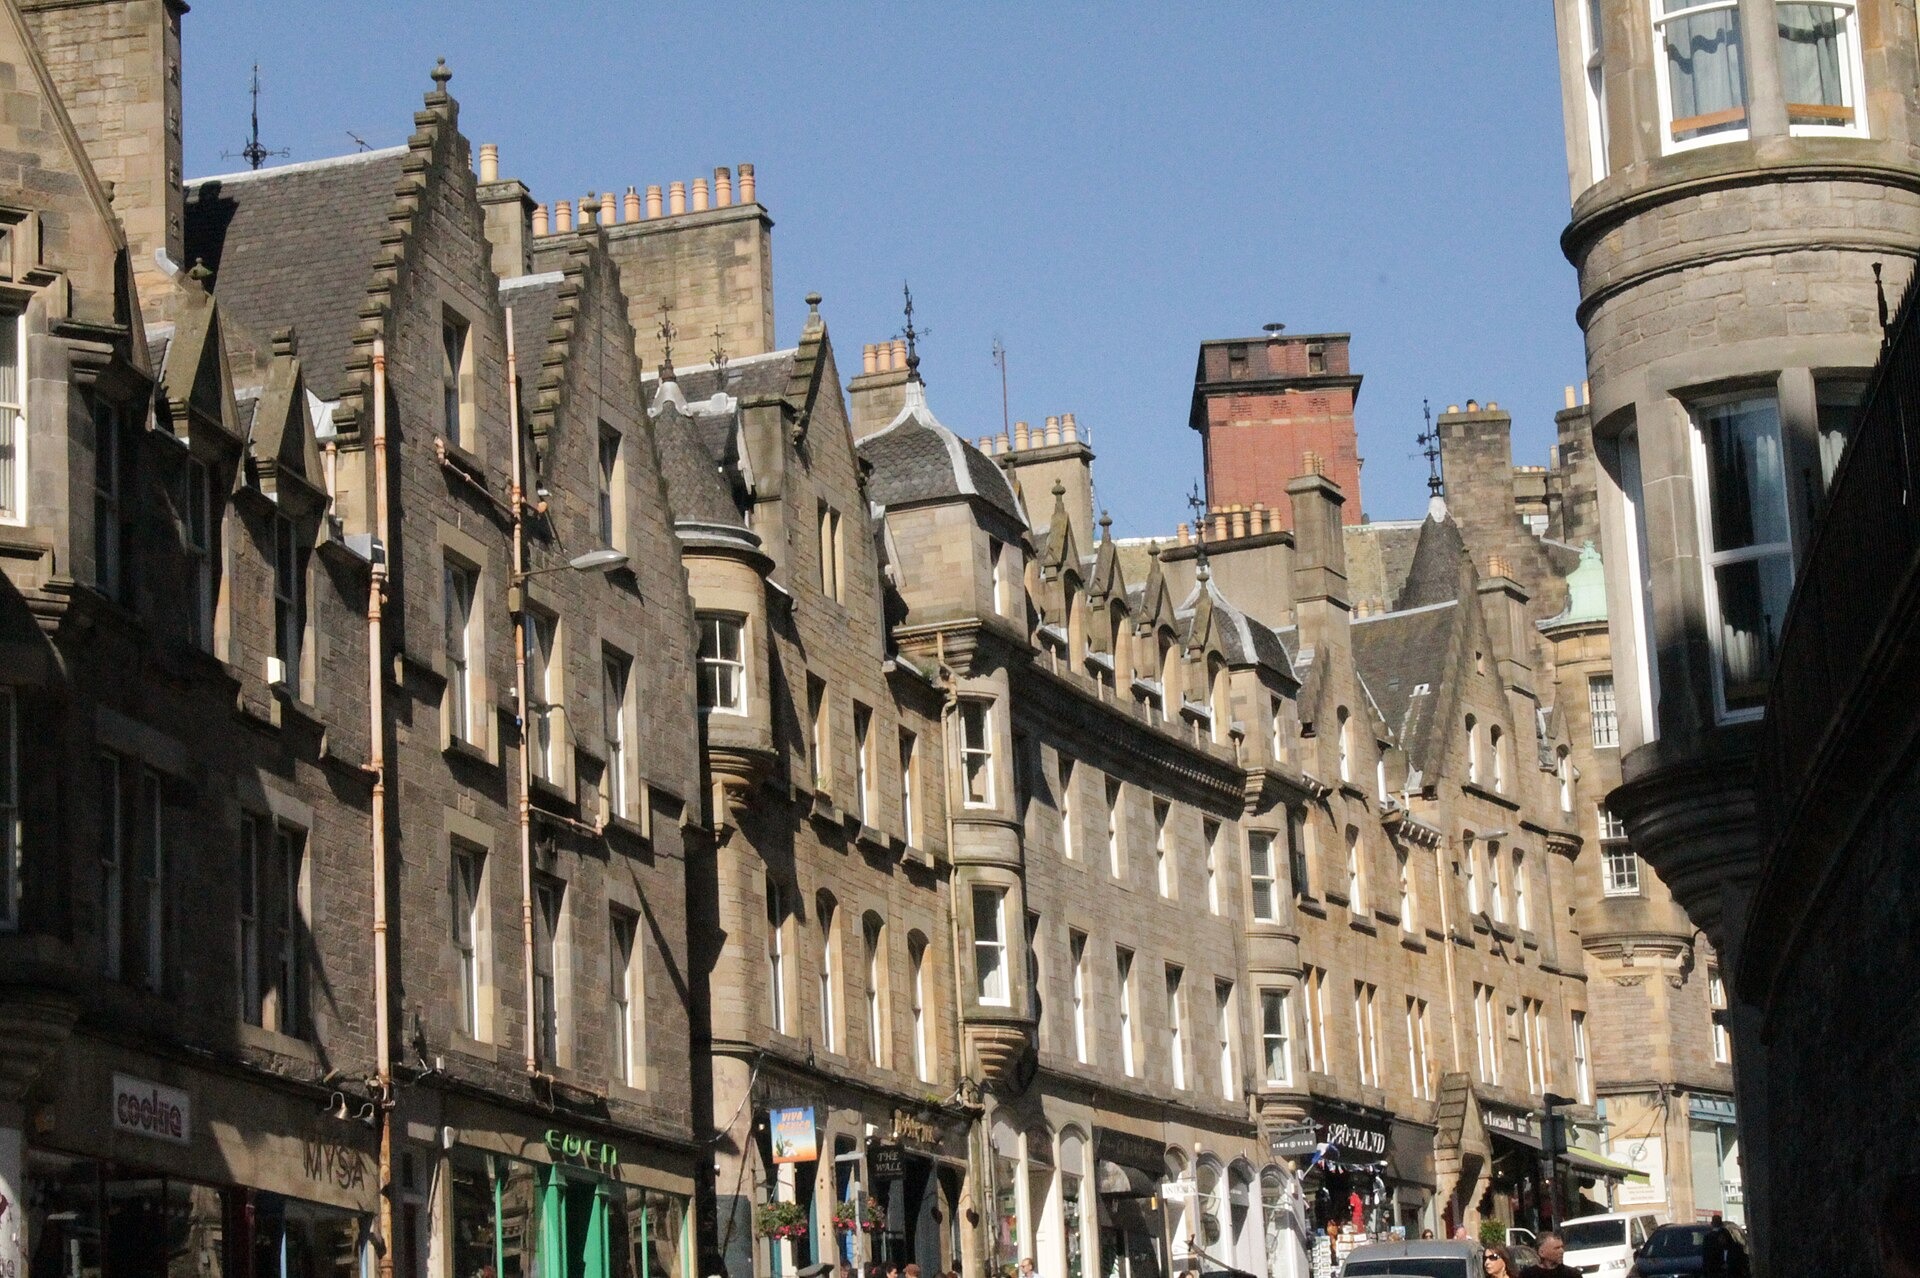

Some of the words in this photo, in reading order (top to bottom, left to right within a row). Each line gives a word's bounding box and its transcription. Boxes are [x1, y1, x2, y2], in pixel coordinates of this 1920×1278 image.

[117, 1088, 182, 1138] cookie
[781, 1111, 803, 1122] VIVA
[1296, 1139, 1312, 1147] TIDE
[1326, 1123, 1385, 1154] SCOTLAND
[877, 1151, 899, 1162] THE
[875, 1161, 903, 1172] WALL
